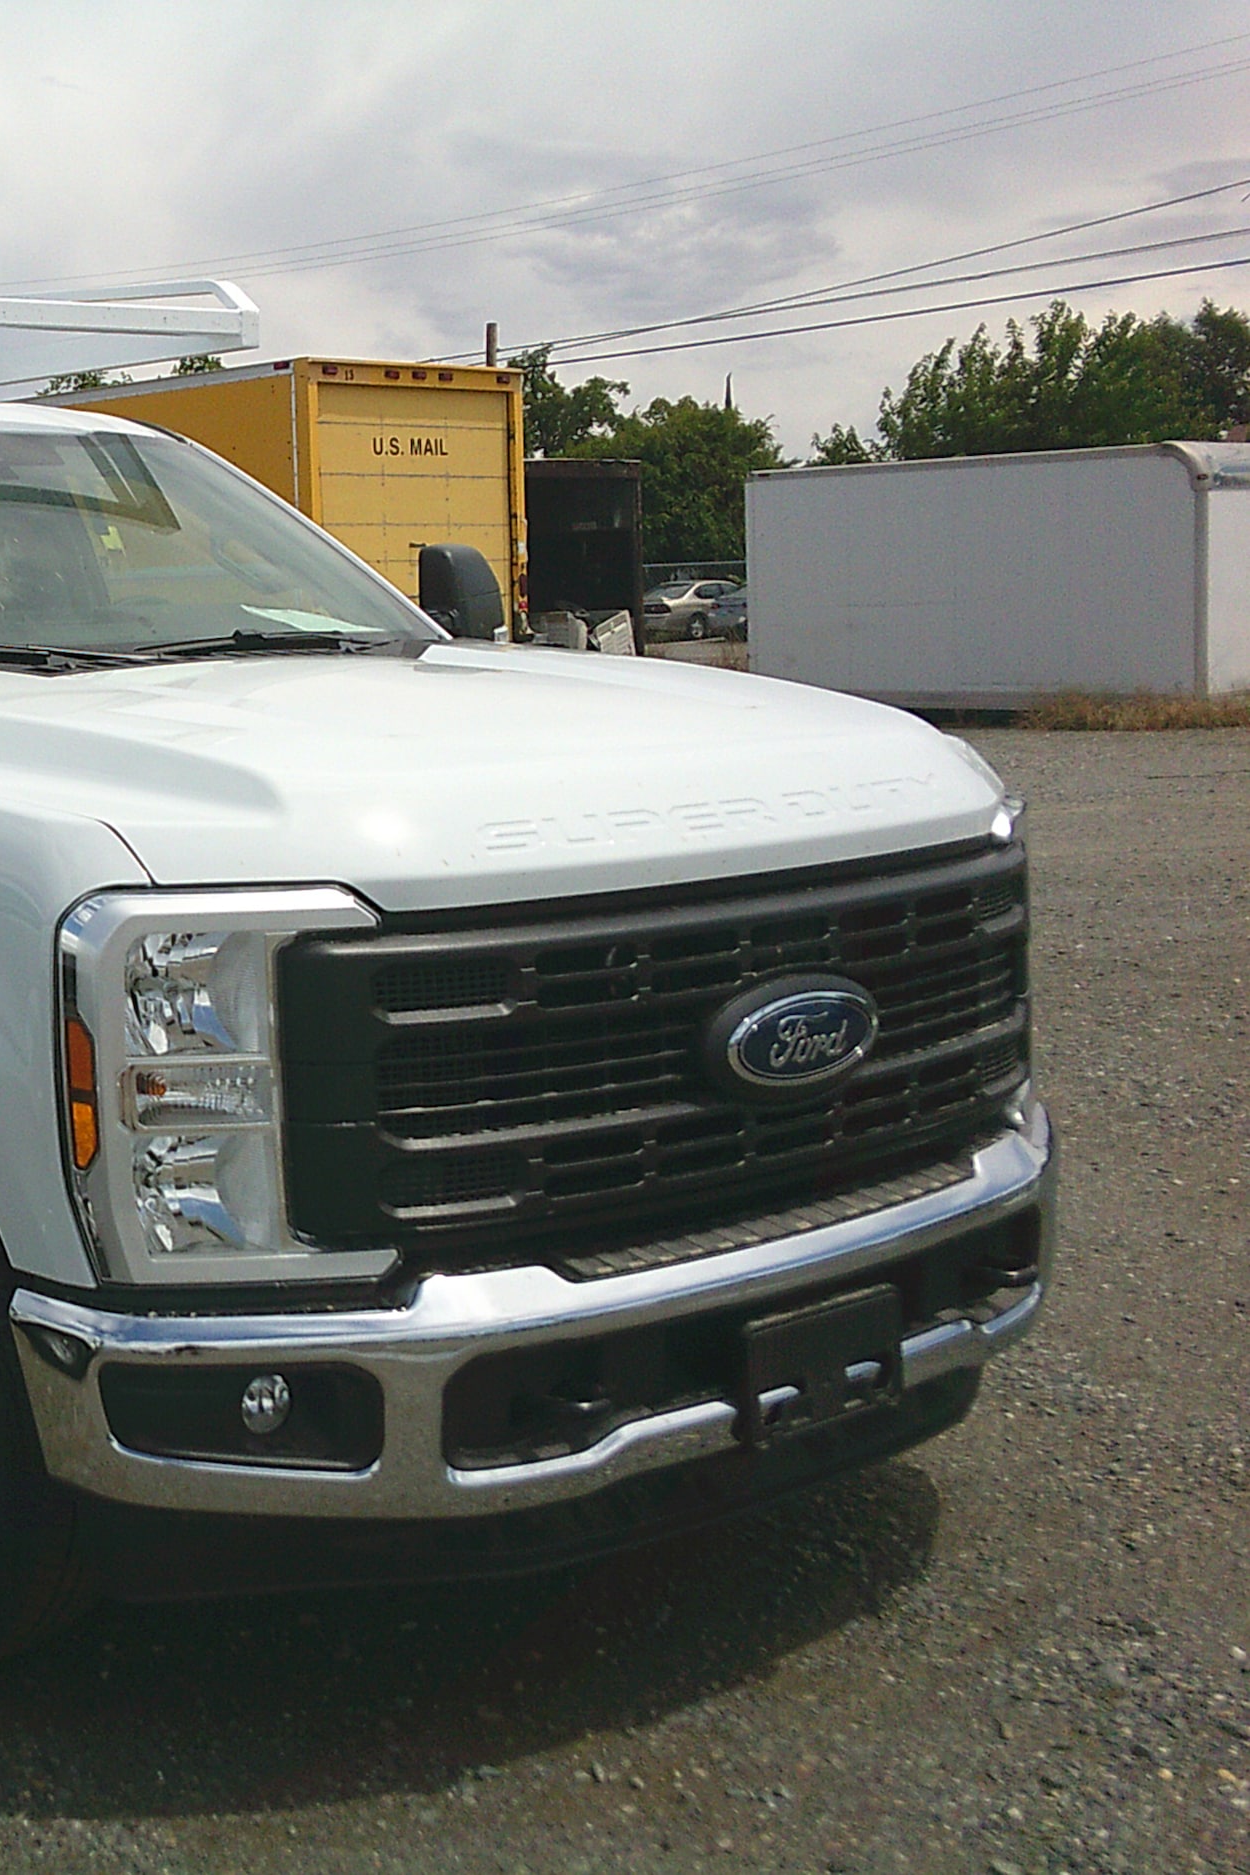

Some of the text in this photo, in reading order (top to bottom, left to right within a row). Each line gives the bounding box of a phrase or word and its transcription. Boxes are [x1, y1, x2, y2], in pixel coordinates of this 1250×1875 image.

[372, 436, 448, 456] U.S. MAIL
[769, 1010, 849, 1069] Ford
